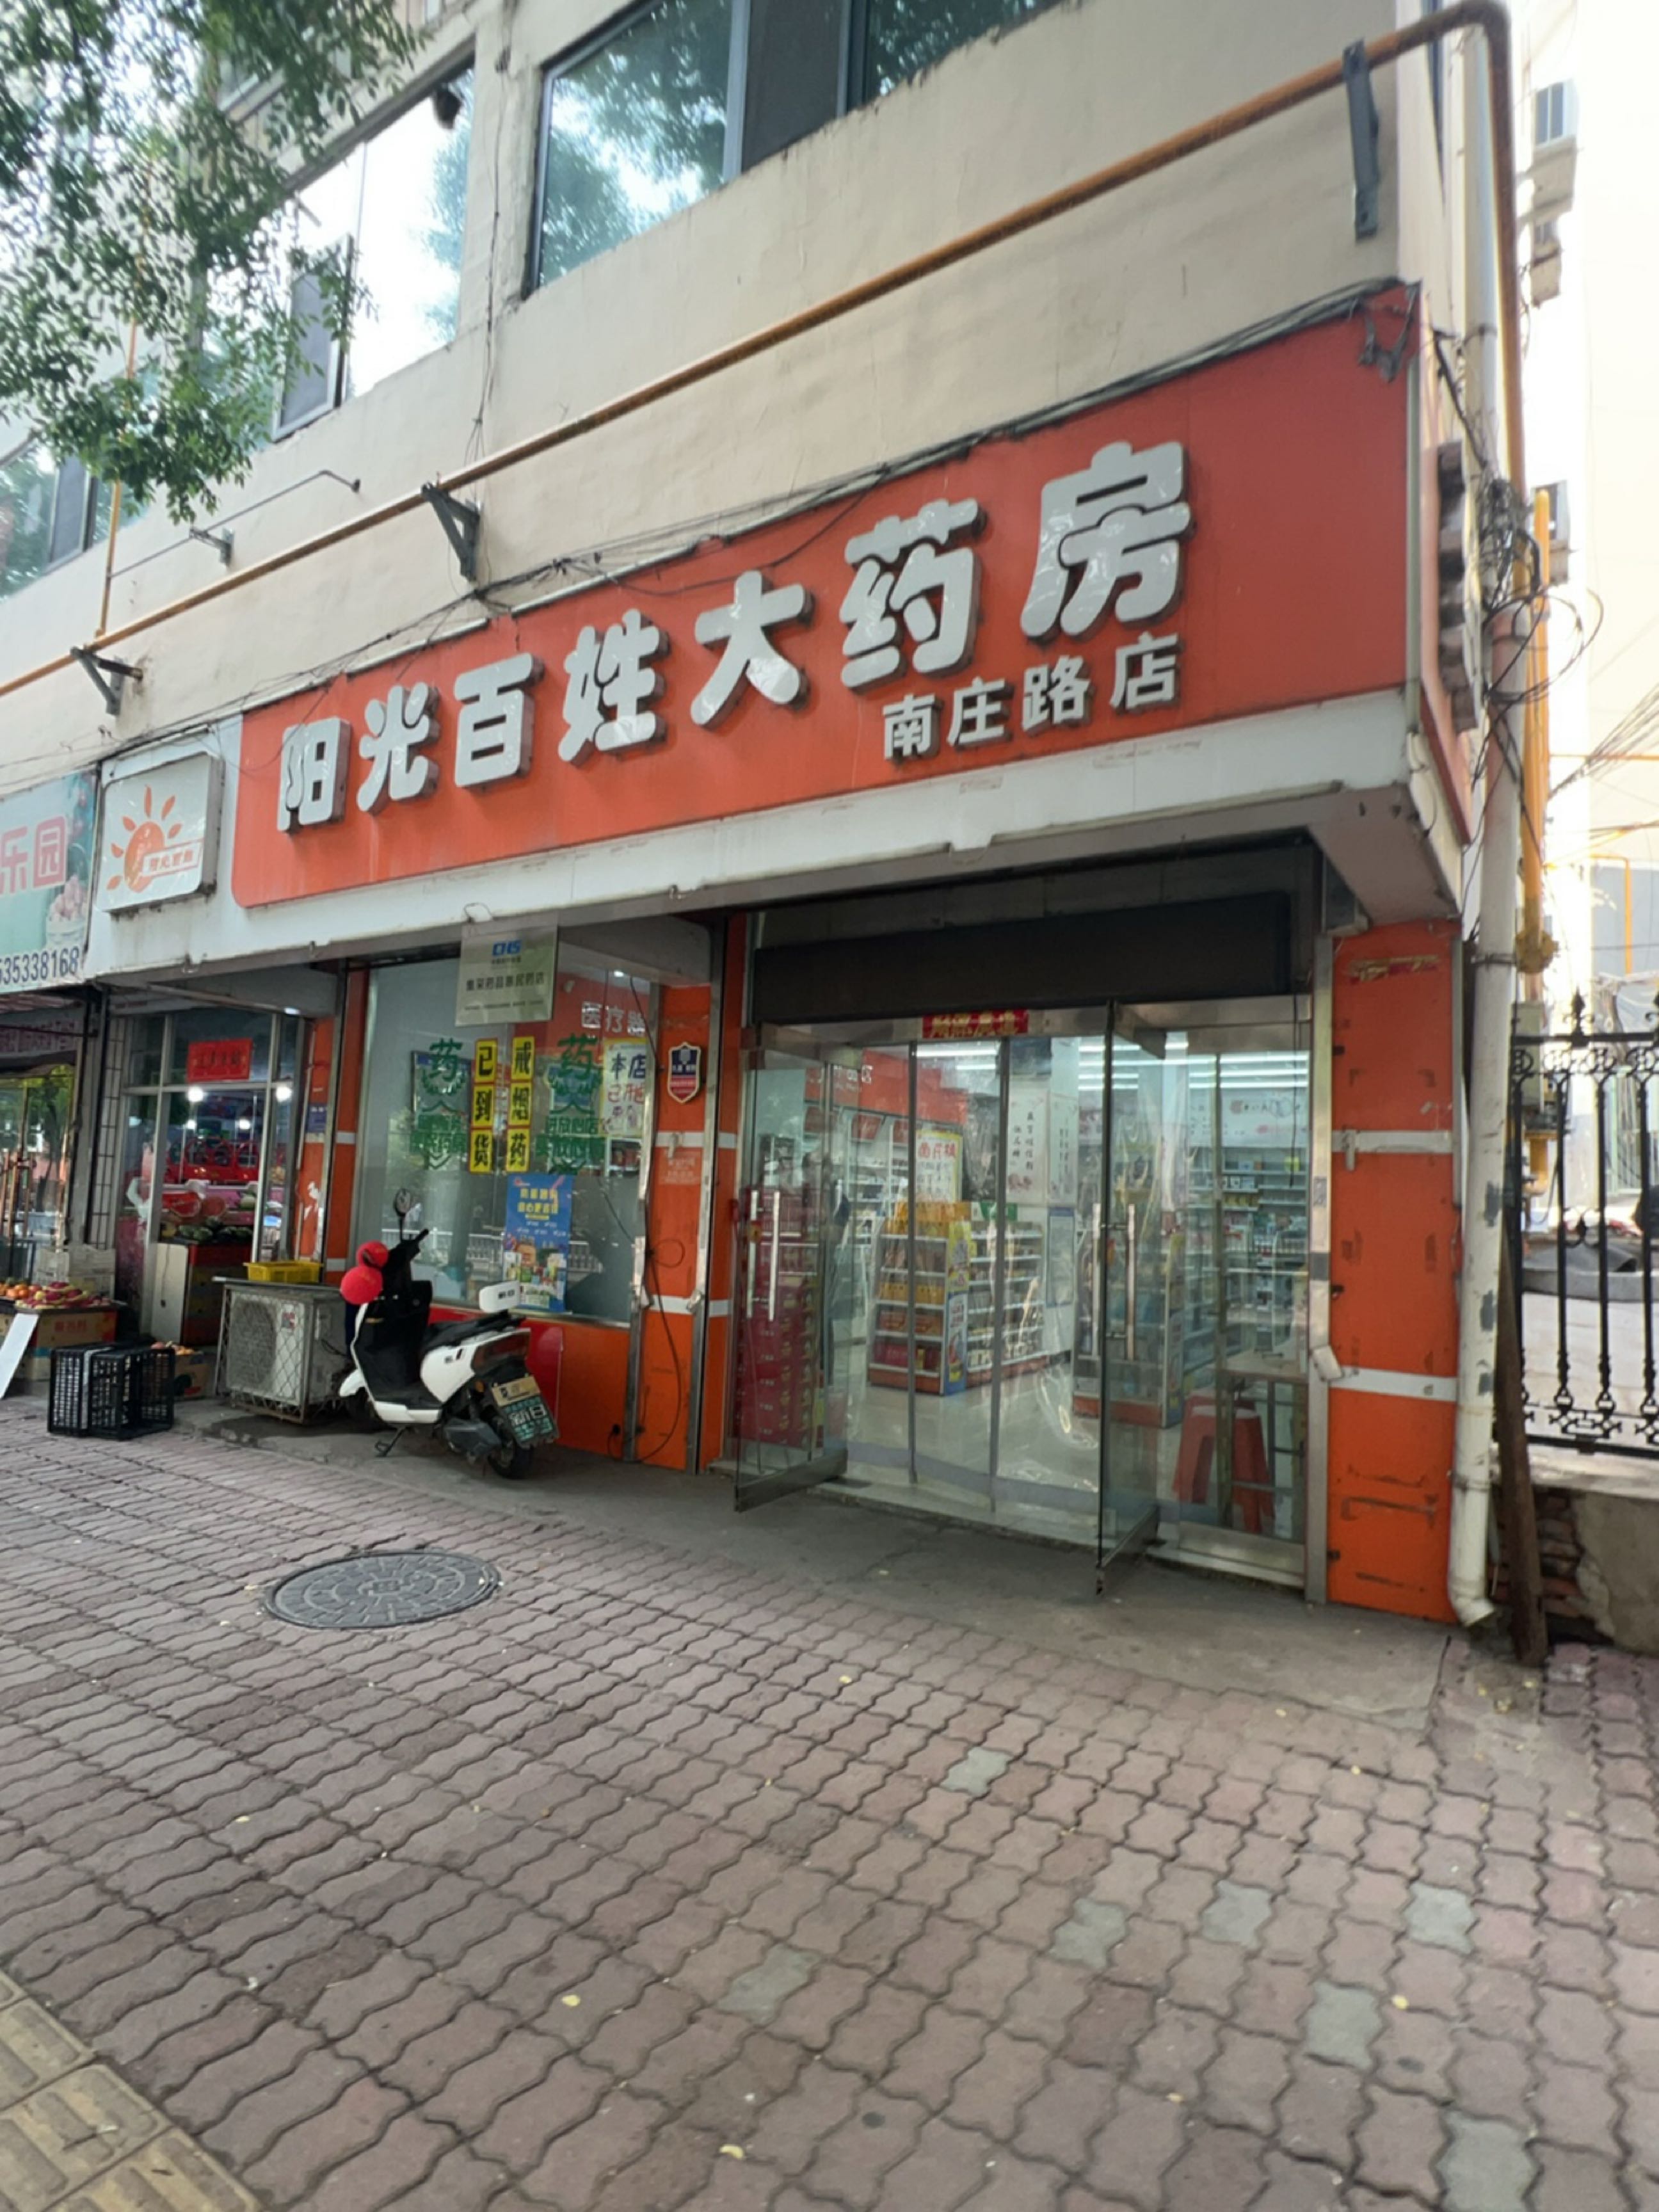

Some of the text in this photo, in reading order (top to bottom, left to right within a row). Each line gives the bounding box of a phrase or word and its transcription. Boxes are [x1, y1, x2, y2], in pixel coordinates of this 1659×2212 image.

[276, 442, 1190, 832] 阳光百姓大药房
[883, 632, 1179, 759] 南庄路店
[0, 945, 79, 985] 35338168
[429, 1037, 463, 1083] 药
[557, 1033, 598, 1080] 药
[474, 1046, 493, 1168] 已到货
